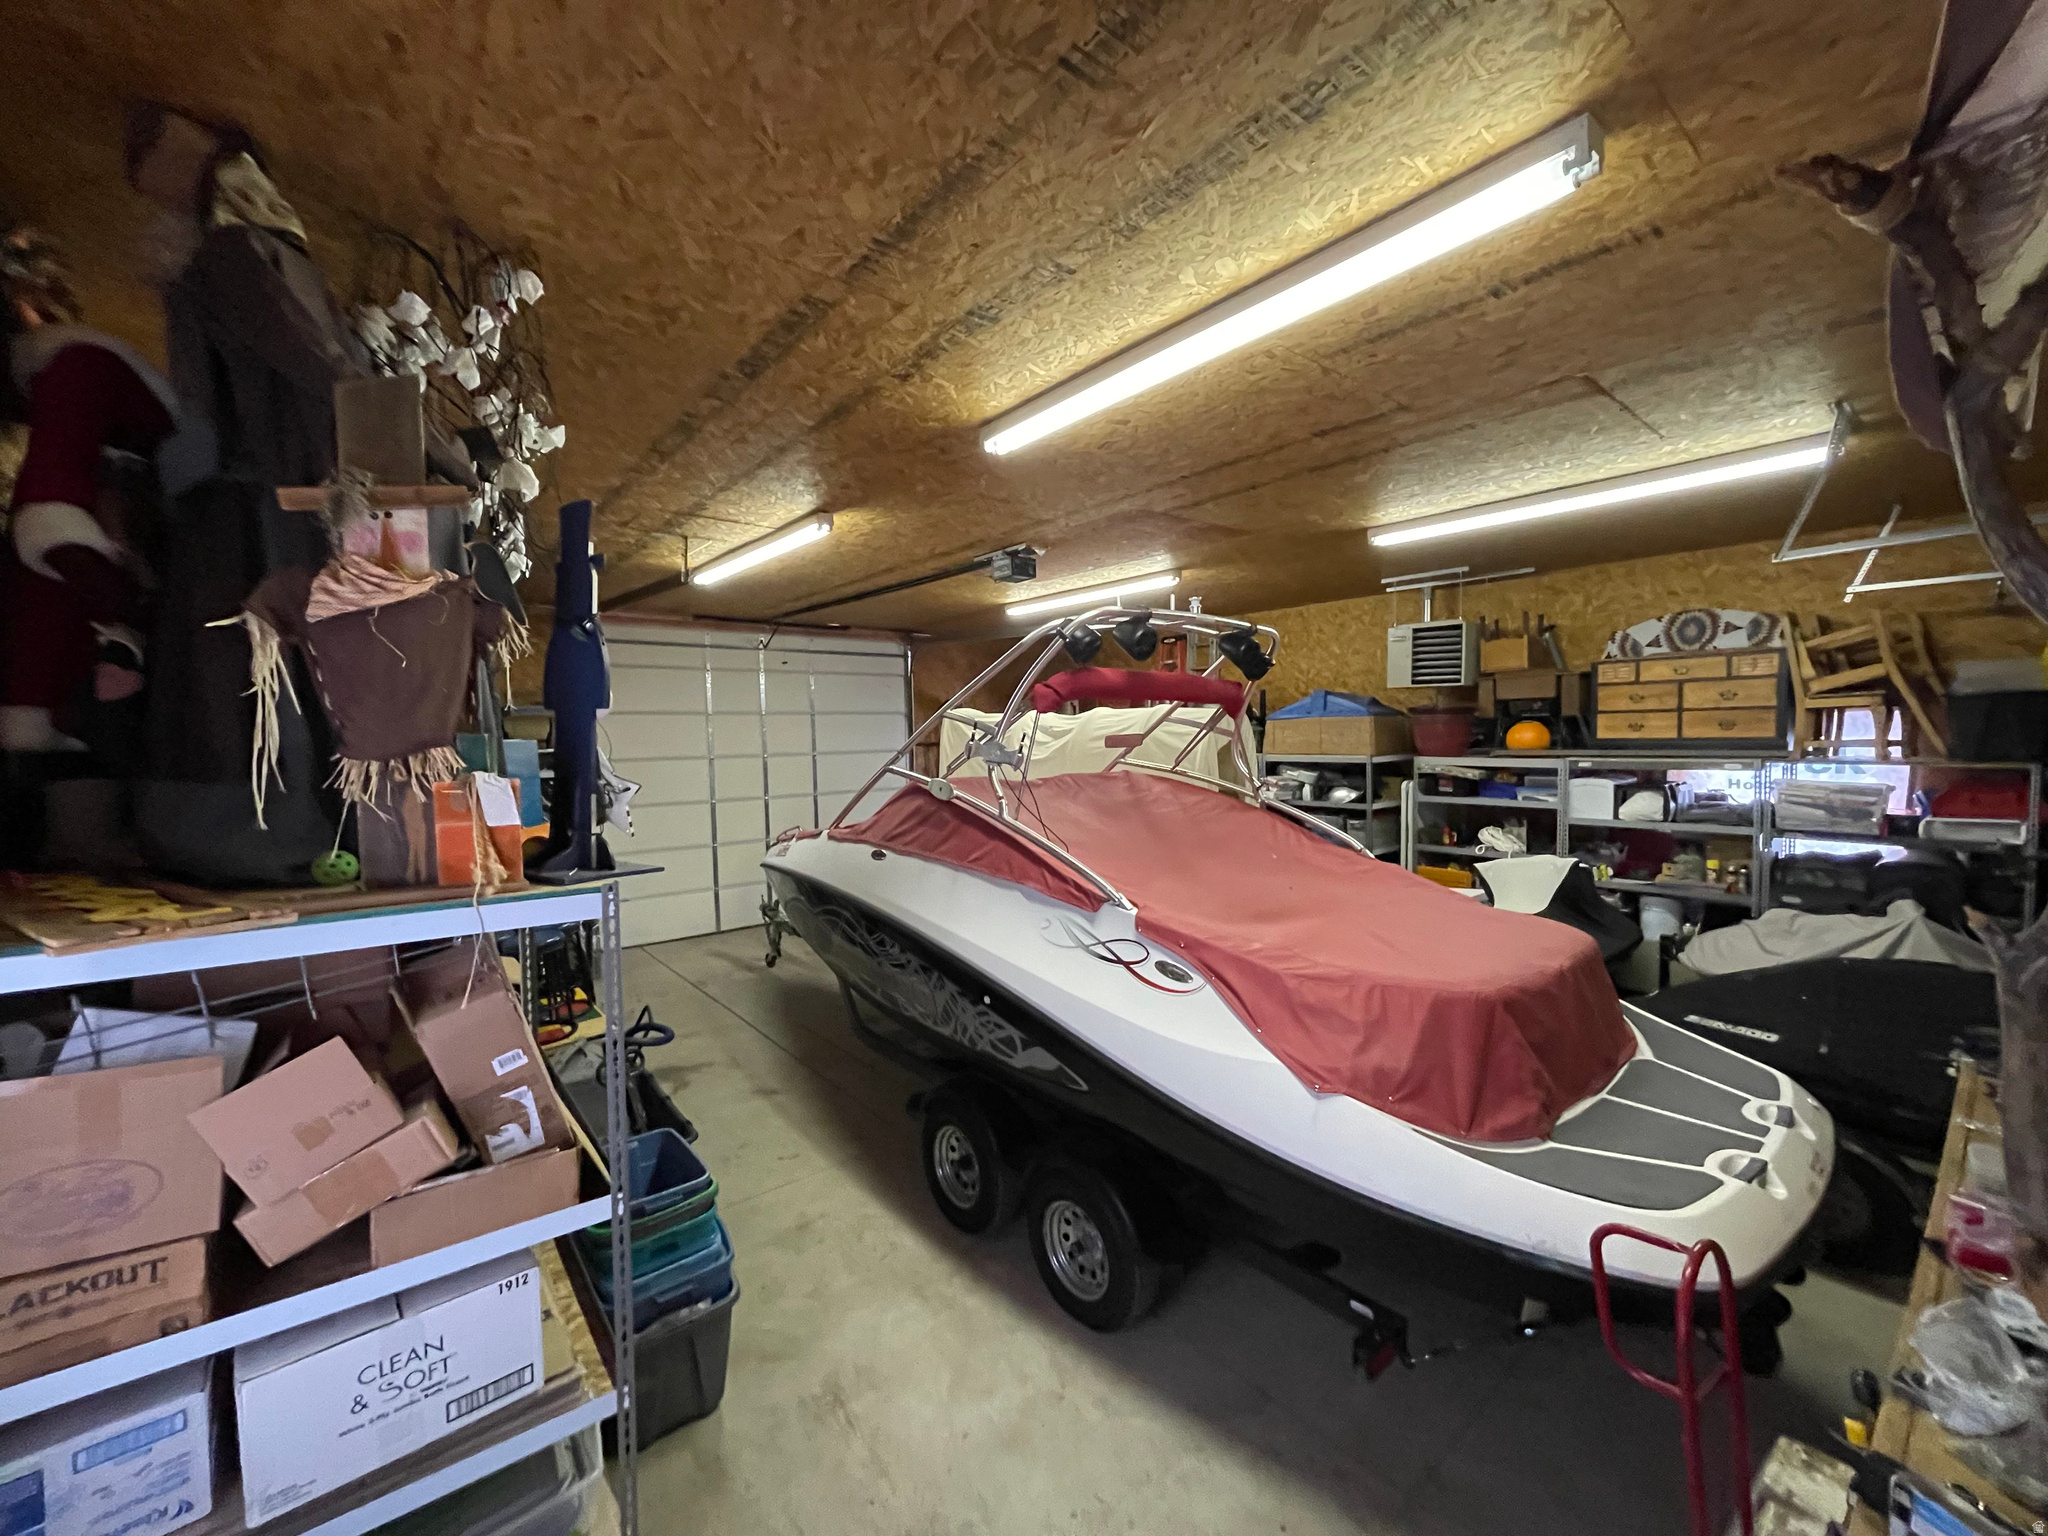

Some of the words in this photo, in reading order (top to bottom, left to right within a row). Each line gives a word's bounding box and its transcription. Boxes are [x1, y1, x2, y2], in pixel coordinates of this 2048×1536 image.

[0, 1257, 168, 1319] ACKOUT
[498, 1273, 529, 1295] 1912
[350, 1394, 369, 1415] &
[378, 1352, 458, 1402] SOFT
[357, 1335, 445, 1385] CLEAN
